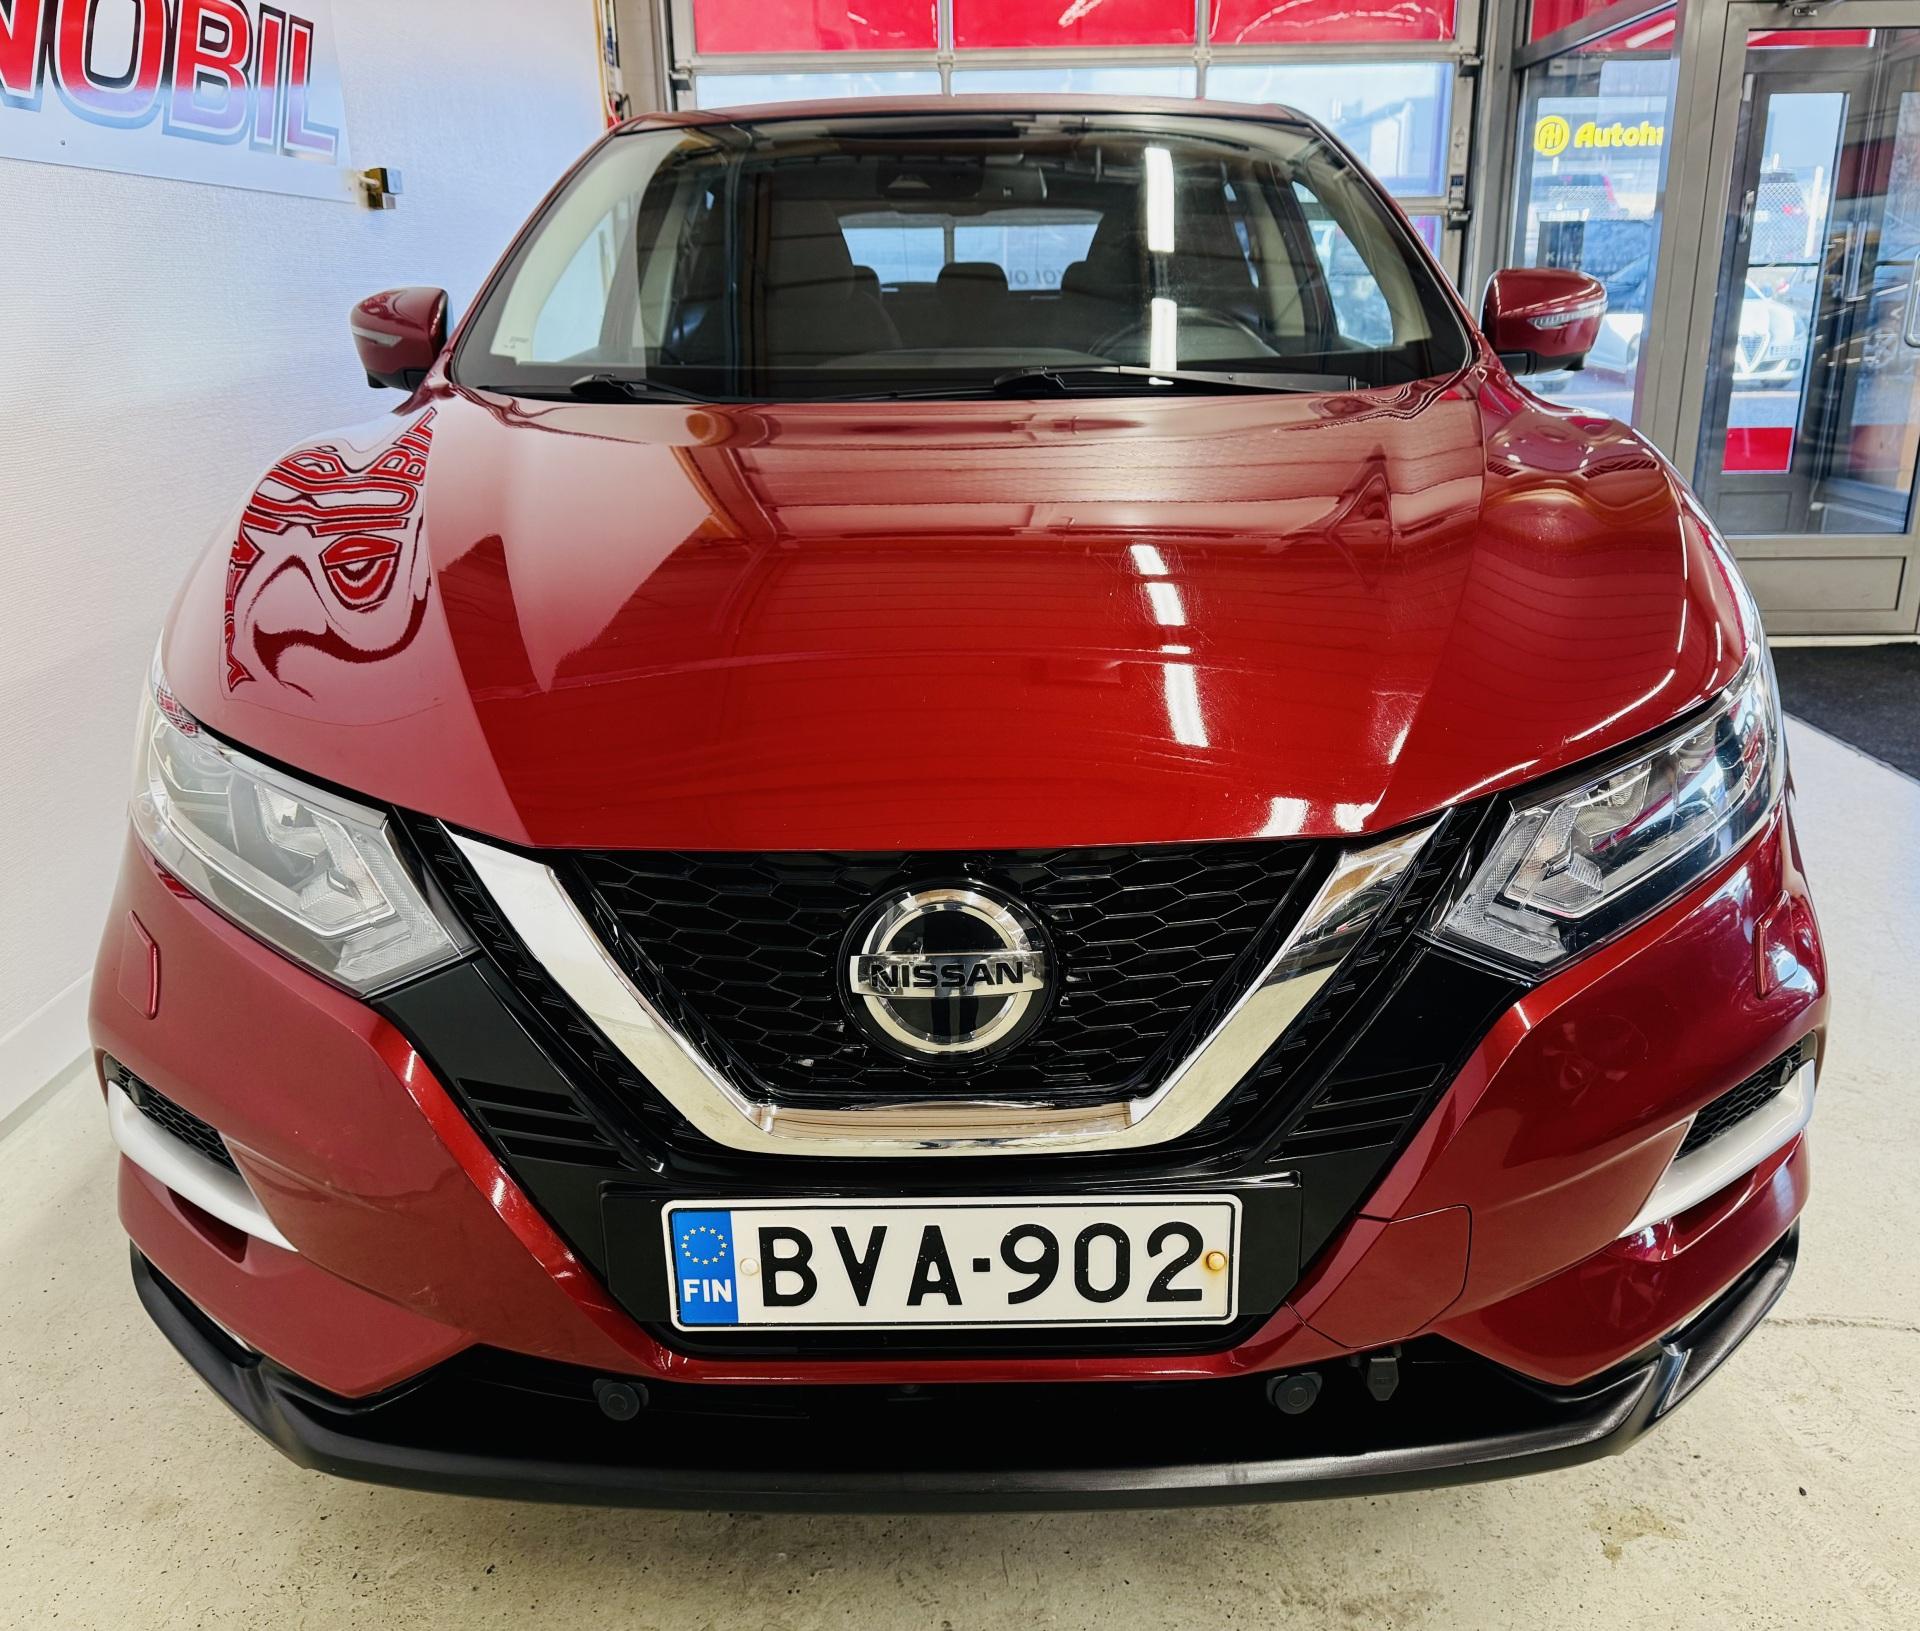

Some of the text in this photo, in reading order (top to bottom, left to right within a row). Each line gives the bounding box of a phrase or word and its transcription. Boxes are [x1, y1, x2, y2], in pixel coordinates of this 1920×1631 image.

[870, 961, 1024, 989] NISSAN
[683, 1221, 1203, 1307] FIN BVA-902
